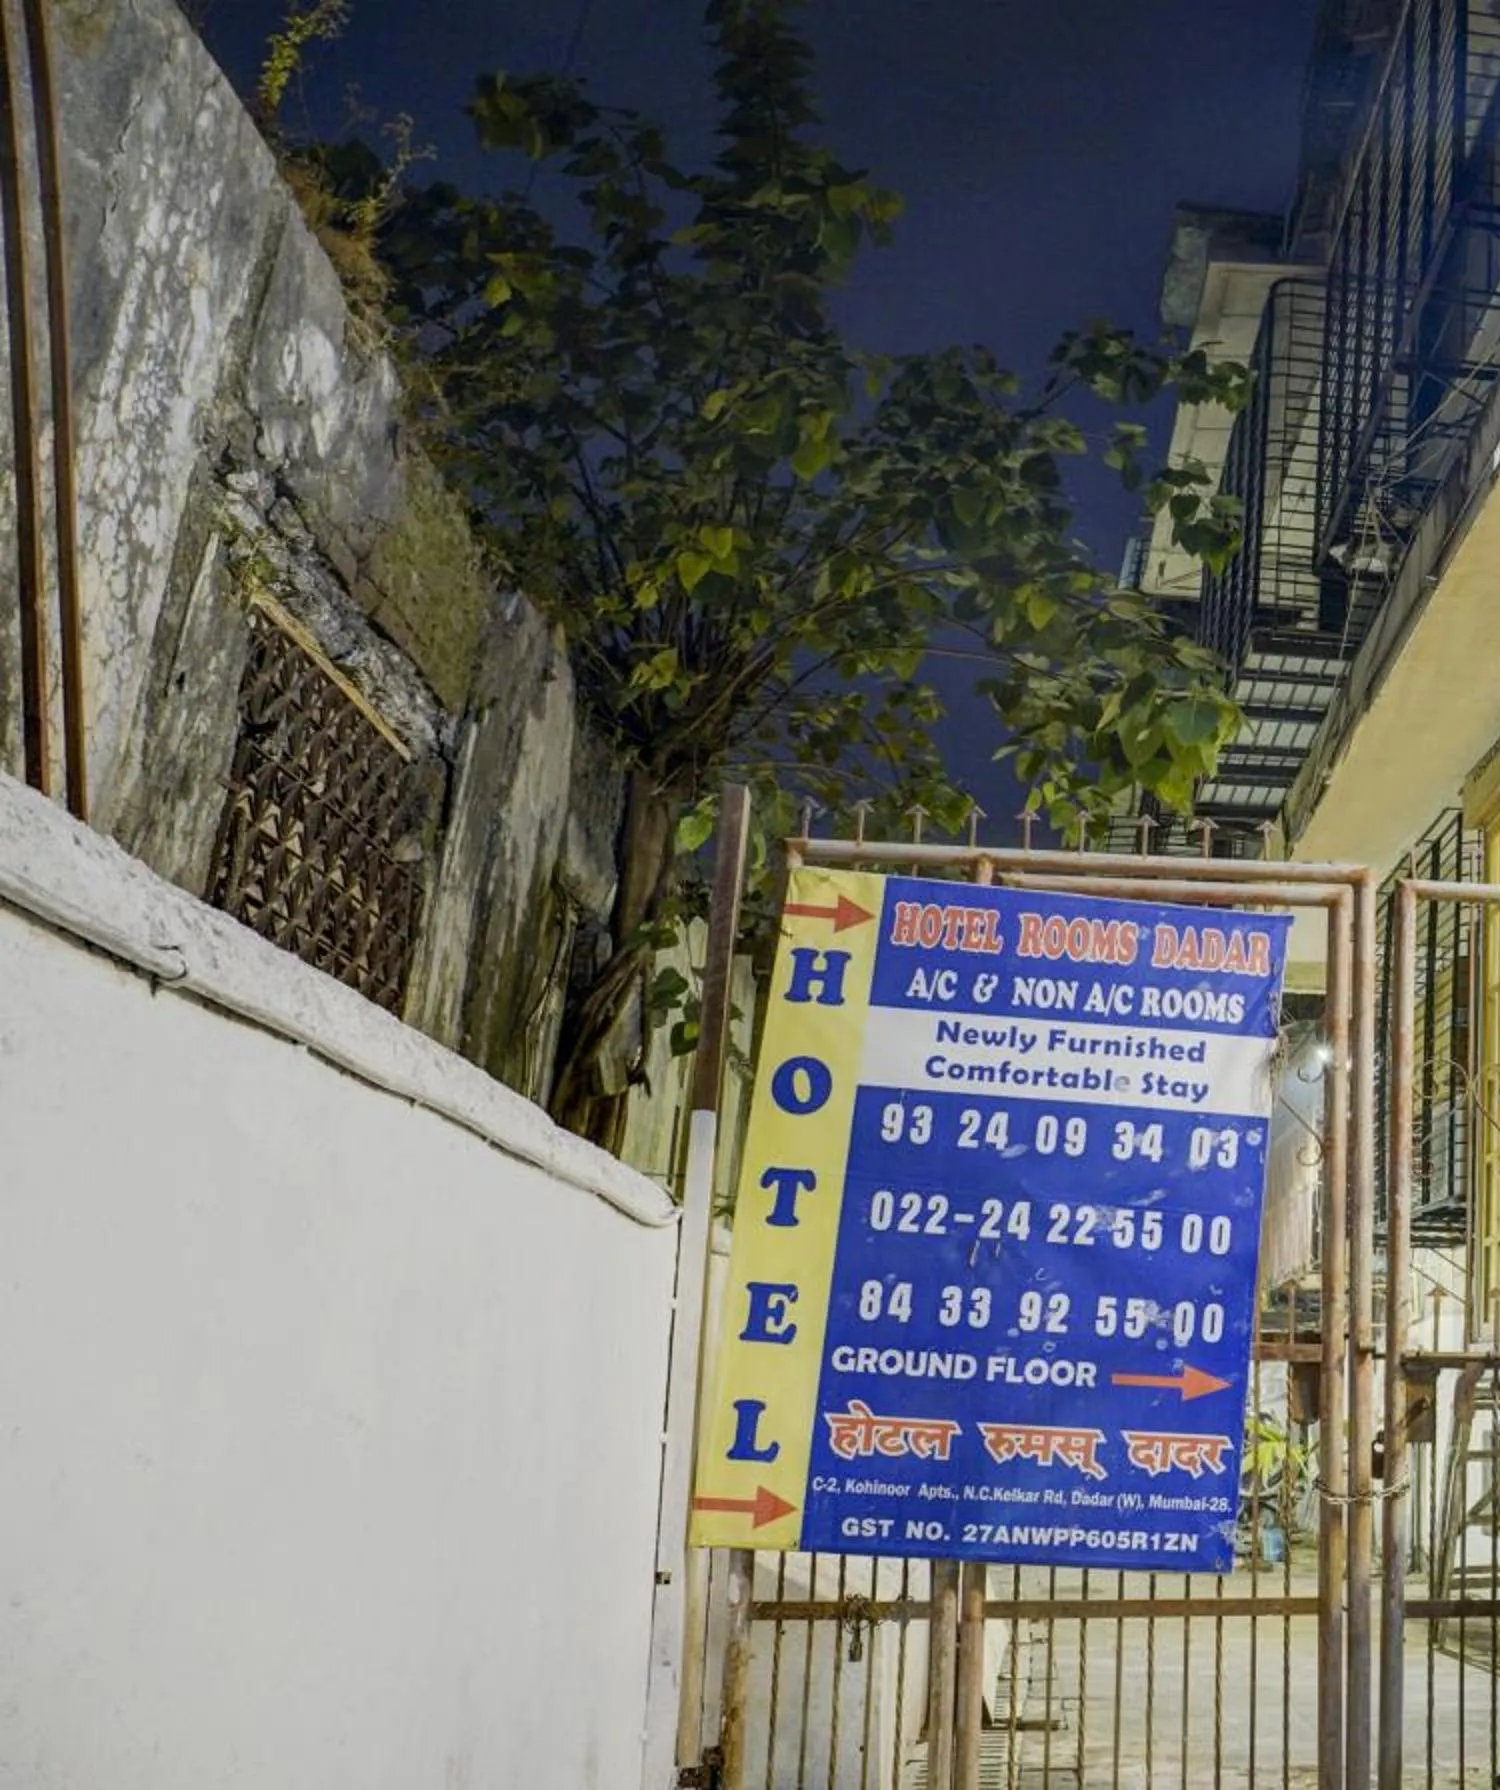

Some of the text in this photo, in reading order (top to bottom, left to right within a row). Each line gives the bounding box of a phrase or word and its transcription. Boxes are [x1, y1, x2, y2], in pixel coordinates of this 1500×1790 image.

[891, 901, 1272, 977] HOTEL ROOMS DADAR
[906, 967, 1246, 1024] A/C & NON A/C ROOMS
[936, 1020, 1207, 1063] Newly Furnished
[925, 1055, 1209, 1103] Comfortable Stay
[880, 1103, 1239, 1169] 93 24 09 34 03
[726, 947, 853, 1463] HOTEL
[870, 1190, 1232, 1256] 022-24 22 55 00
[858, 1280, 1224, 1345] 84 33 92 55 00
[831, 1345, 1098, 1388] GROUND FLOOR
[824, 1399, 963, 1461] होटल
[1121, 1429, 1235, 1478] दादर
[812, 1476, 841, 1494] C-2,
[845, 1479, 911, 1497] Kohinoor
[1072, 1490, 1115, 1507] Dadar
[841, 1516, 895, 1538] GST
[905, 1520, 950, 1541] NO.
